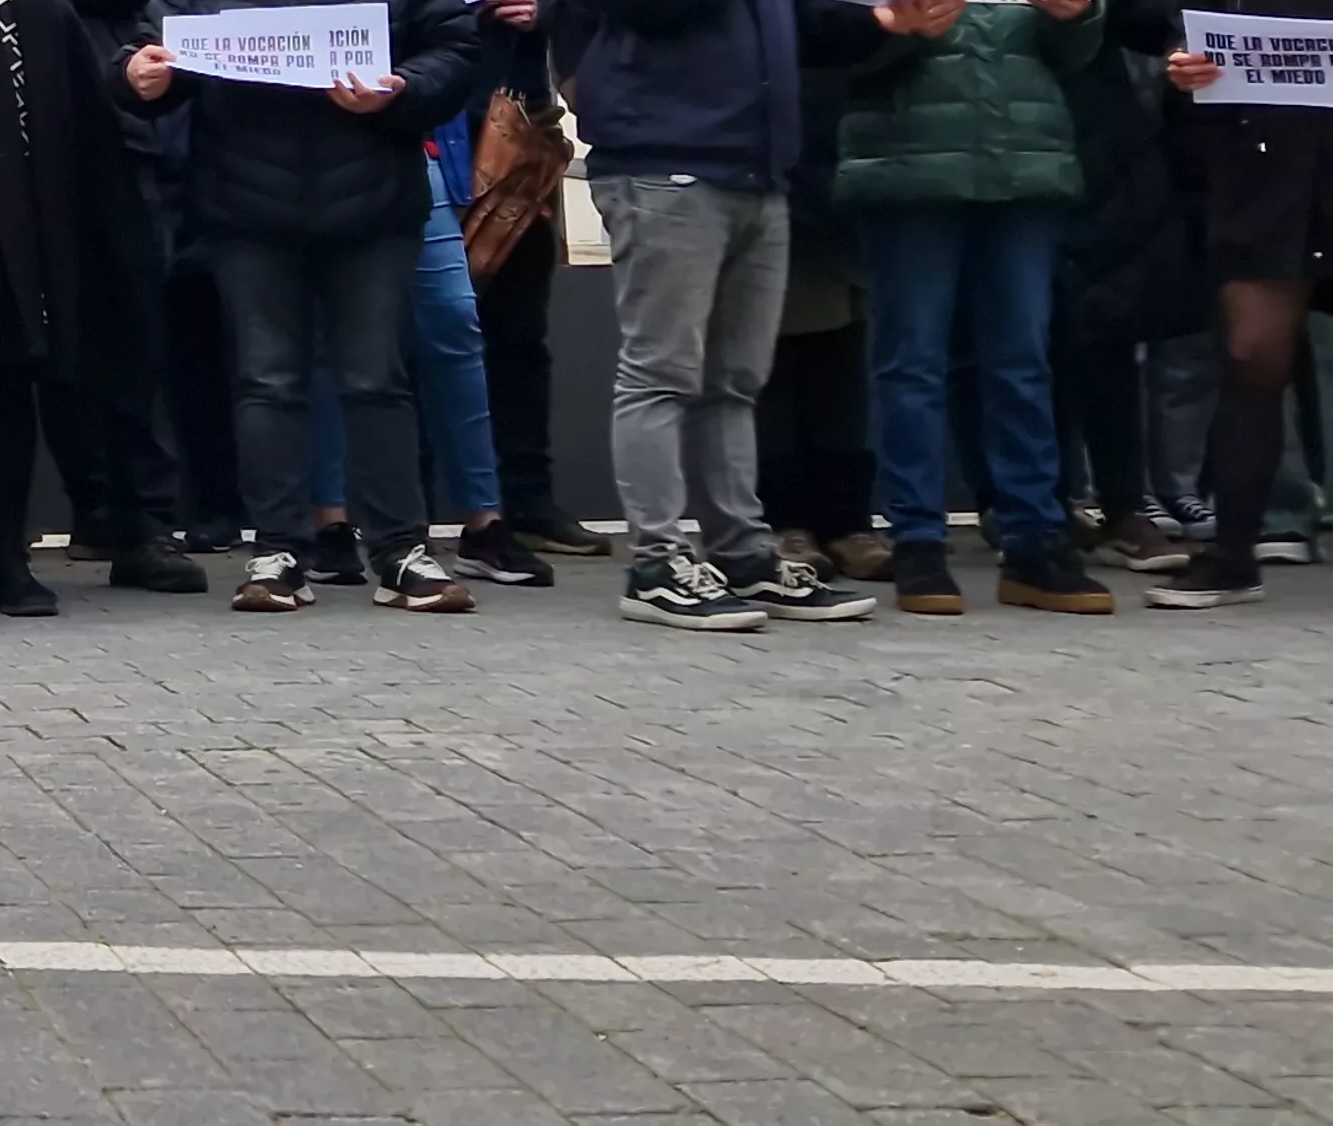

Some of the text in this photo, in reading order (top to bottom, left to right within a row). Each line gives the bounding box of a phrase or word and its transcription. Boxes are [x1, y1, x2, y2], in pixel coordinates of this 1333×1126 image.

[214, 37, 231, 52] LA
[237, 31, 311, 52] VOCACIÓN
[1205, 32, 1237, 51] QUE
[1242, 36, 1263, 52] LA
[286, 55, 315, 69] POR
[345, 50, 374, 67] POR
[1232, 53, 1254, 67] SE
[1260, 54, 1322, 68] ROMPA
[1245, 69, 1326, 85] EL MIEDO
